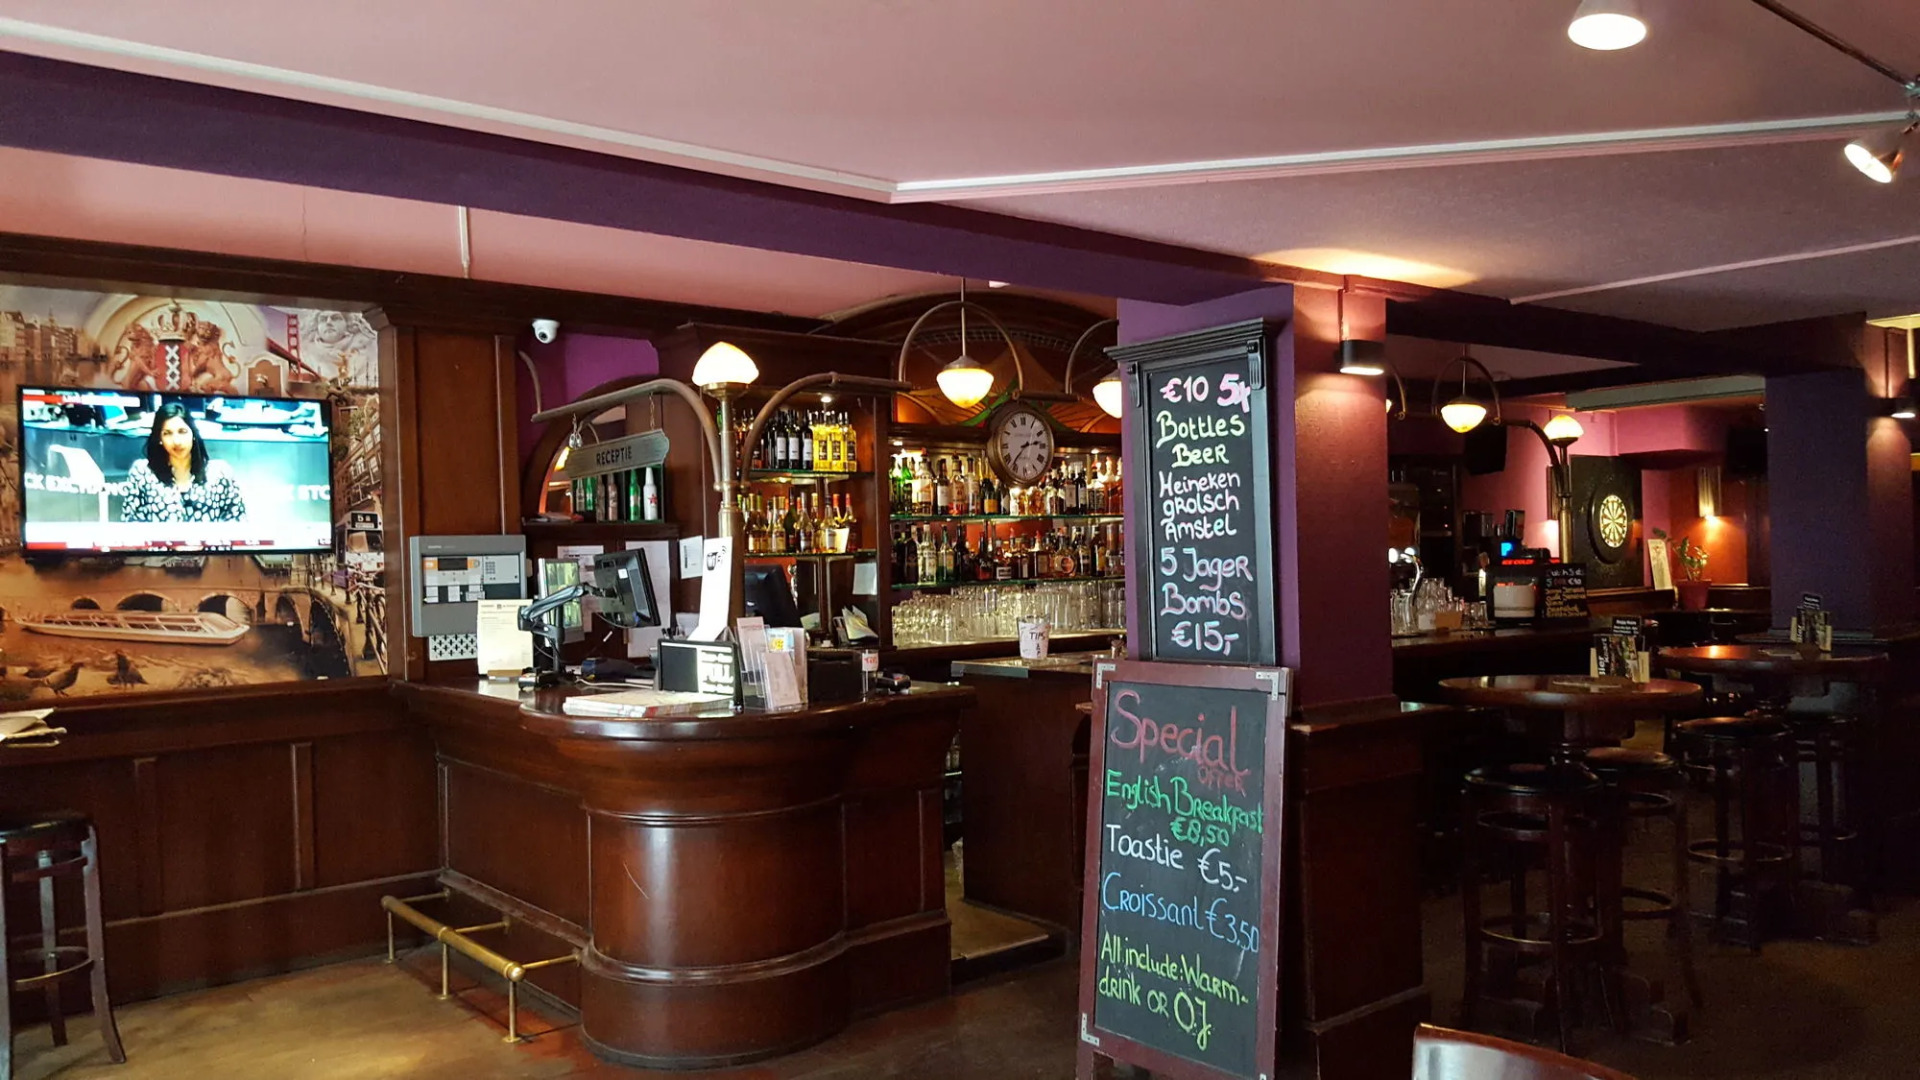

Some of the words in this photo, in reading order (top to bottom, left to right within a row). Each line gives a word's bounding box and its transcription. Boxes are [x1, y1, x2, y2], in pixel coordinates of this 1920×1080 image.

[1160, 376, 1209, 403] €10
[1156, 411, 1245, 449] Bottles
[596, 446, 632, 467] RECEPTIE
[1159, 470, 1241, 498] Heineken
[1165, 513, 1238, 543] Amstel
[1160, 547, 1177, 576] 5
[1160, 582, 1247, 619] Bombs
[1110, 689, 1250, 766] Special
[1106, 768, 1171, 814] English
[1106, 824, 1185, 870] Toastie
